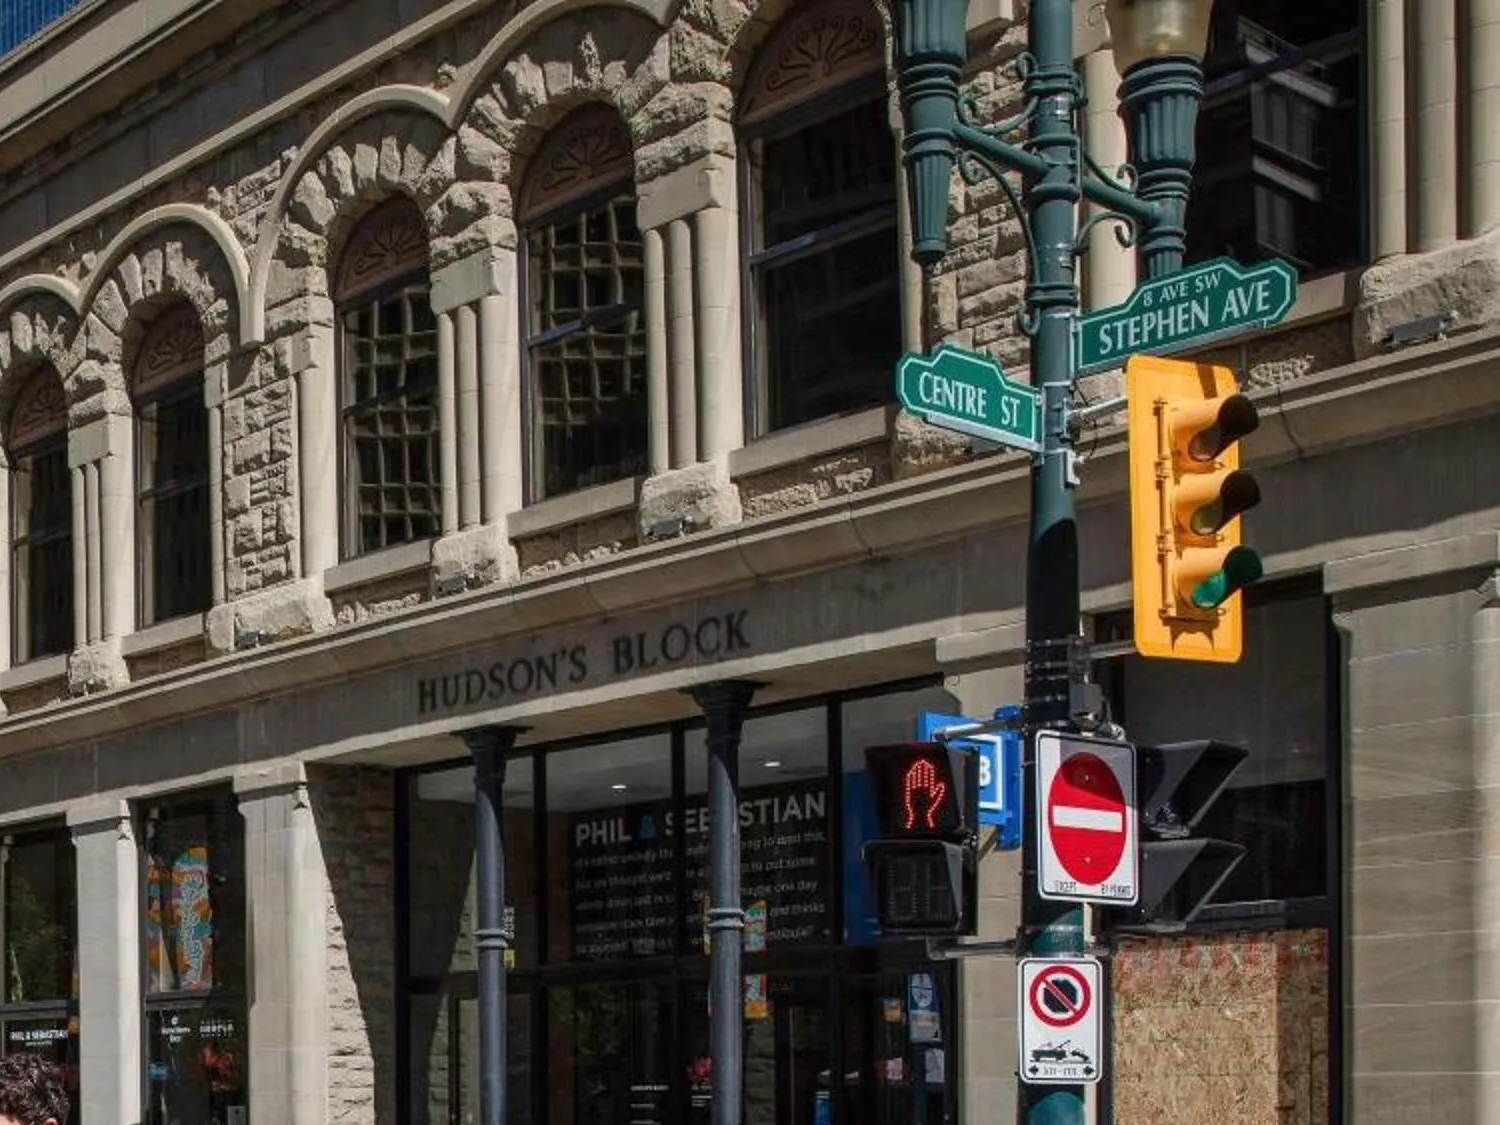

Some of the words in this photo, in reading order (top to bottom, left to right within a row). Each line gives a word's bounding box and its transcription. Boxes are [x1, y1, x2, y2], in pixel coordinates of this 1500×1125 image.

[1098, 294, 1210, 355] STEPHEN
[1222, 279, 1271, 321] AVE
[1143, 289, 1153, 307] 8
[1158, 281, 1188, 304] AVE
[1195, 271, 1223, 295] SW
[918, 371, 987, 419] CENTRE
[1000, 396, 1022, 428] ST
[418, 645, 588, 714] HUDSON'S
[612, 609, 751, 675] BLOCK
[575, 816, 633, 848] PHIL
[638, 810, 657, 840] &
